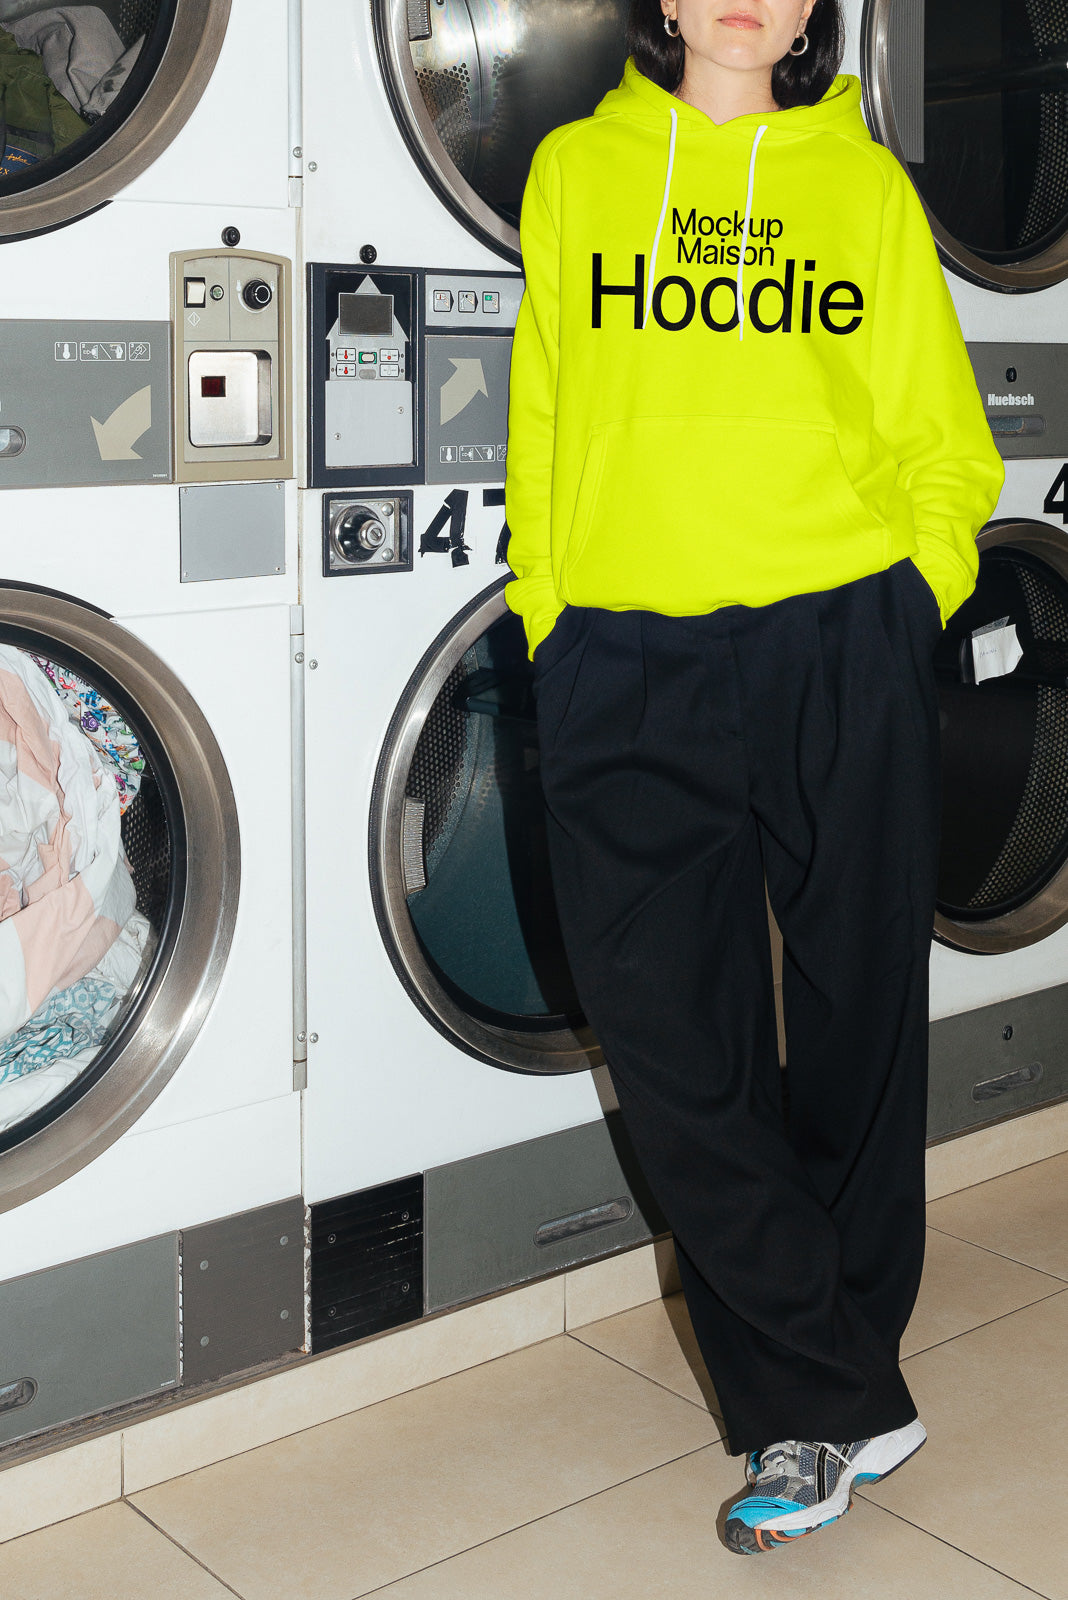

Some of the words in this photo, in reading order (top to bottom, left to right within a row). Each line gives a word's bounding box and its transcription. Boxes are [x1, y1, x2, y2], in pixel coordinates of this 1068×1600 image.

[672, 208, 783, 245] Mockup
[678, 237, 775, 266] Maison
[592, 253, 864, 335] Hoodie
[987, 393, 1035, 406] Huebsch
